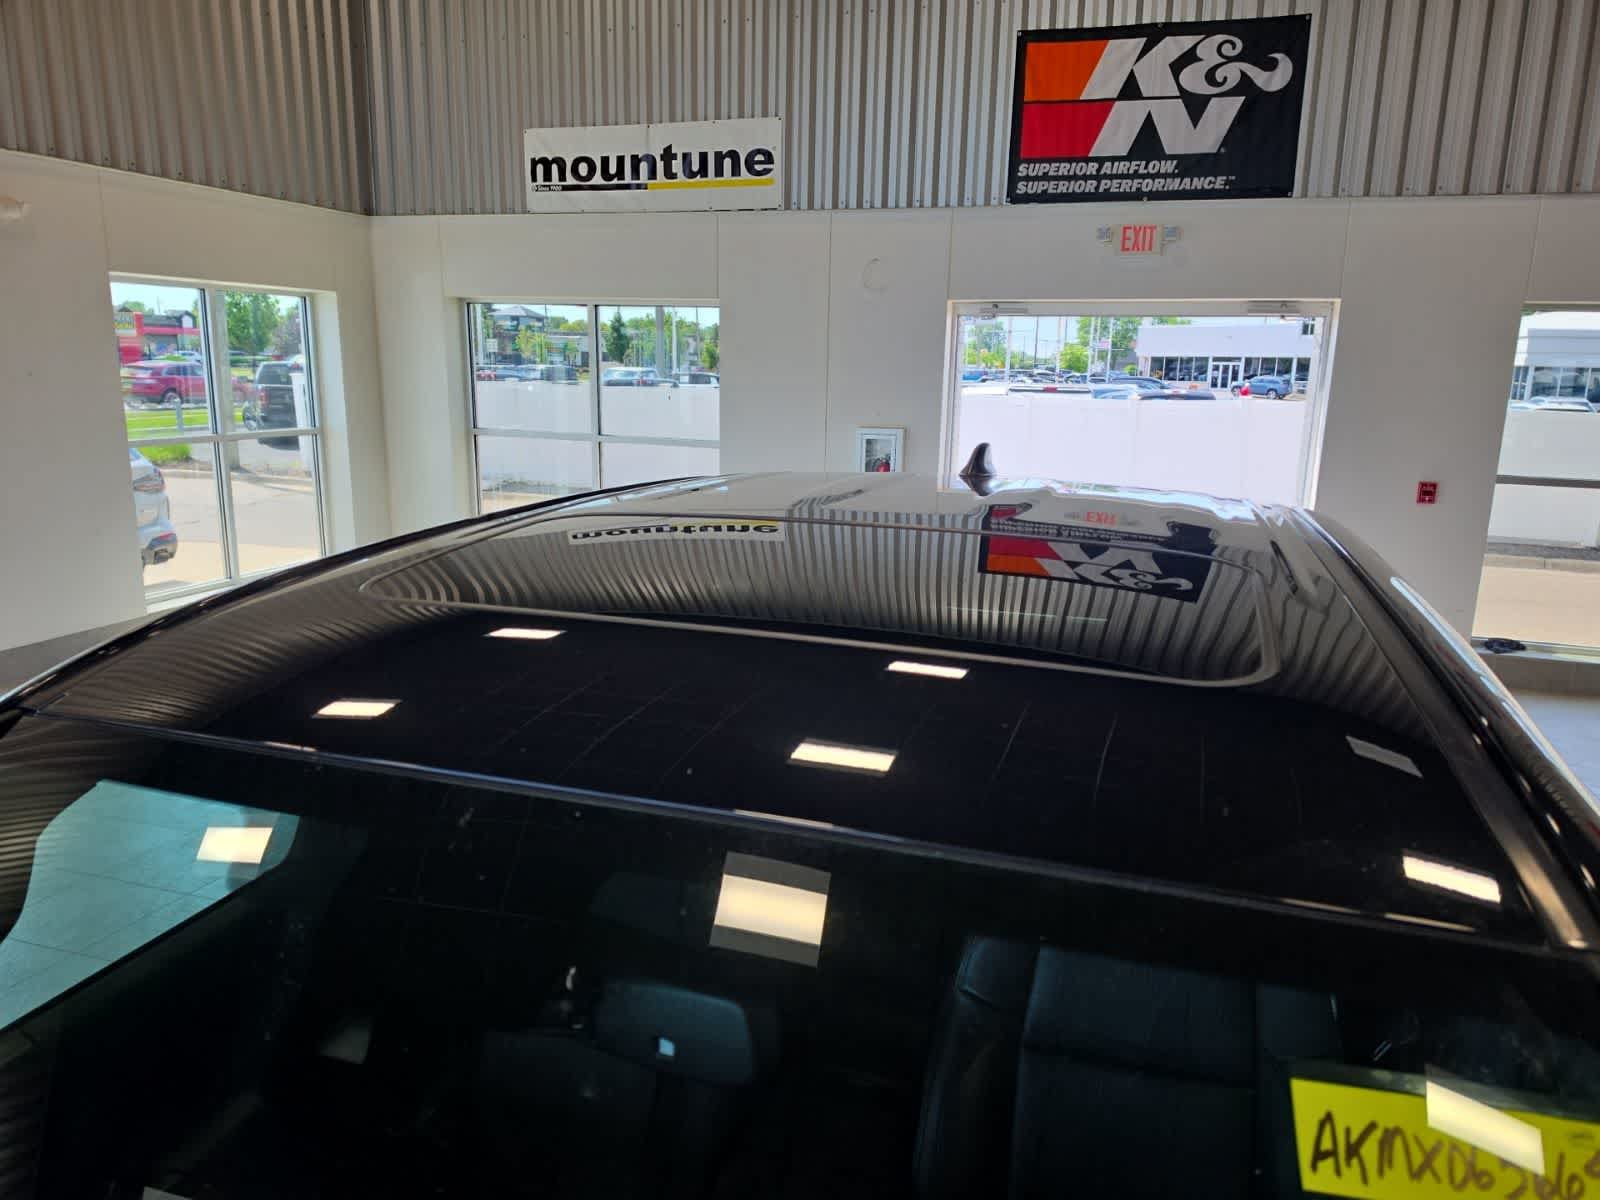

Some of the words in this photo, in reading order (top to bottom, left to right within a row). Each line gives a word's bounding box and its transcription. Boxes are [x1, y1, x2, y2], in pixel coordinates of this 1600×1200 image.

[530, 144, 775, 183] mountune
[1017, 162, 1099, 177] SUPERIOR
[1100, 160, 1179, 175] AIRFLOW.
[1016, 180, 1097, 194] SUPERIOR
[1120, 225, 1157, 252] EXIT
